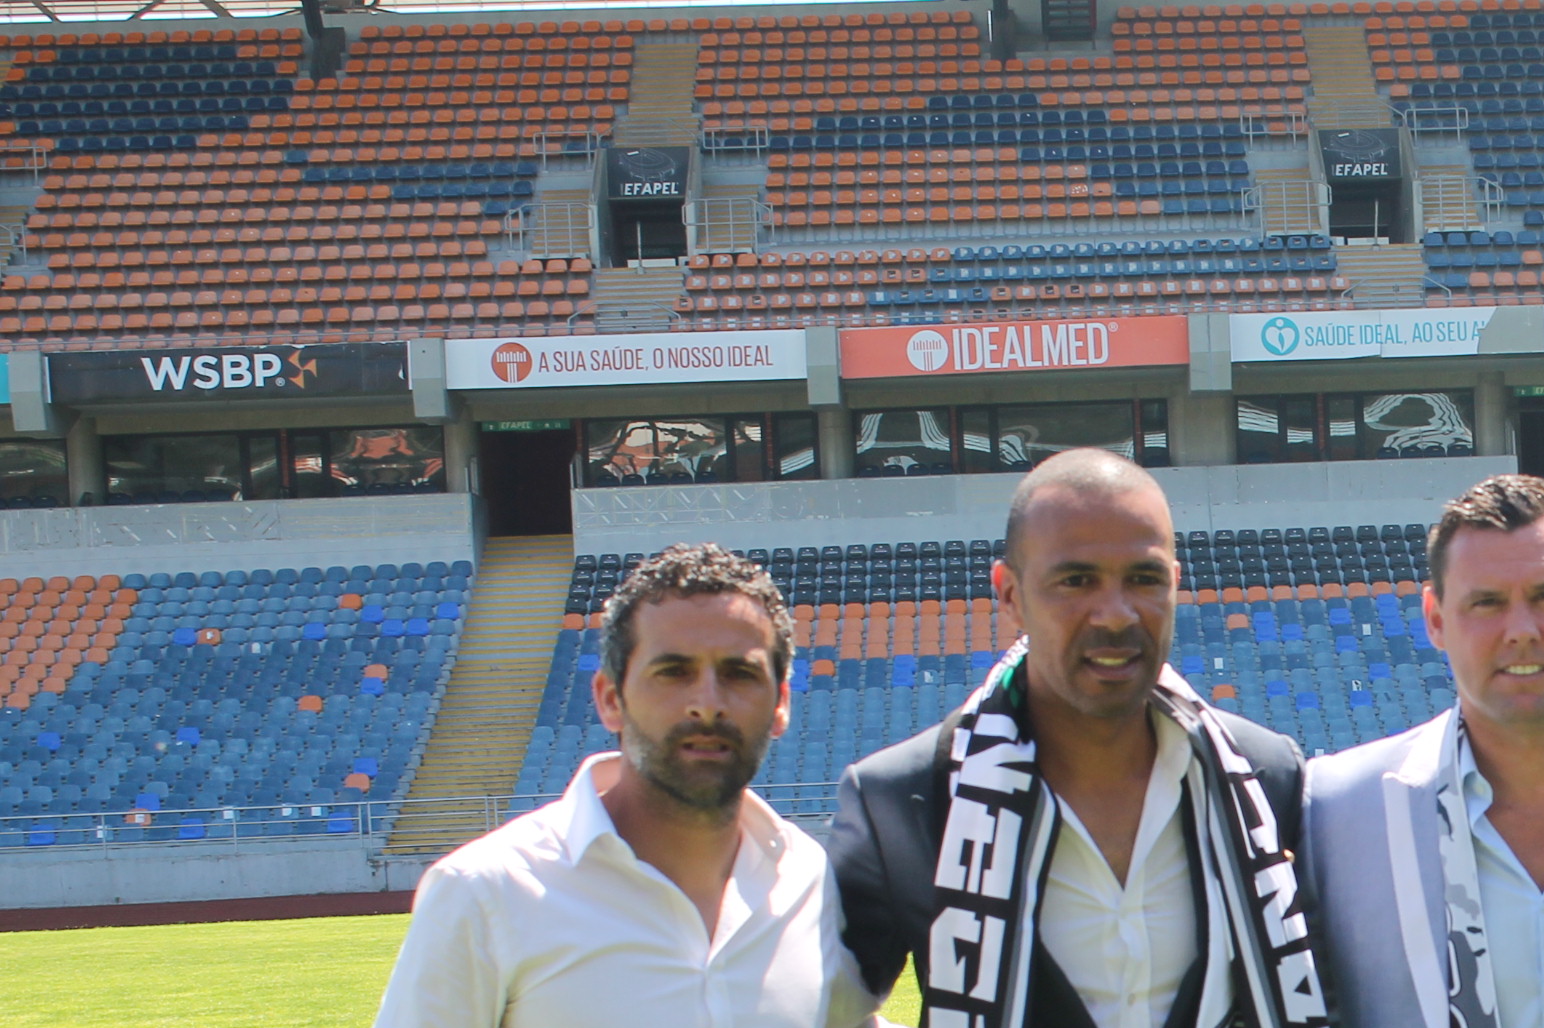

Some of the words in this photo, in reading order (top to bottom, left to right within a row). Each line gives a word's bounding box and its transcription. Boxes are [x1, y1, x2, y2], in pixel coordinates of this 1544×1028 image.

[1334, 163, 1389, 175] EFAPEL
[624, 181, 679, 196] EFAPEL
[1304, 322, 1356, 347] SAÚDE
[1359, 324, 1408, 346] IDEAL,
[1412, 322, 1434, 342] AO
[1436, 321, 1467, 342] SEU
[538, 352, 550, 372] A
[553, 350, 587, 372] SUA
[591, 346, 649, 372] SAÚDE,
[653, 348, 664, 369] O
[668, 346, 724, 368] NOSSO
[727, 345, 774, 367] IDEAL
